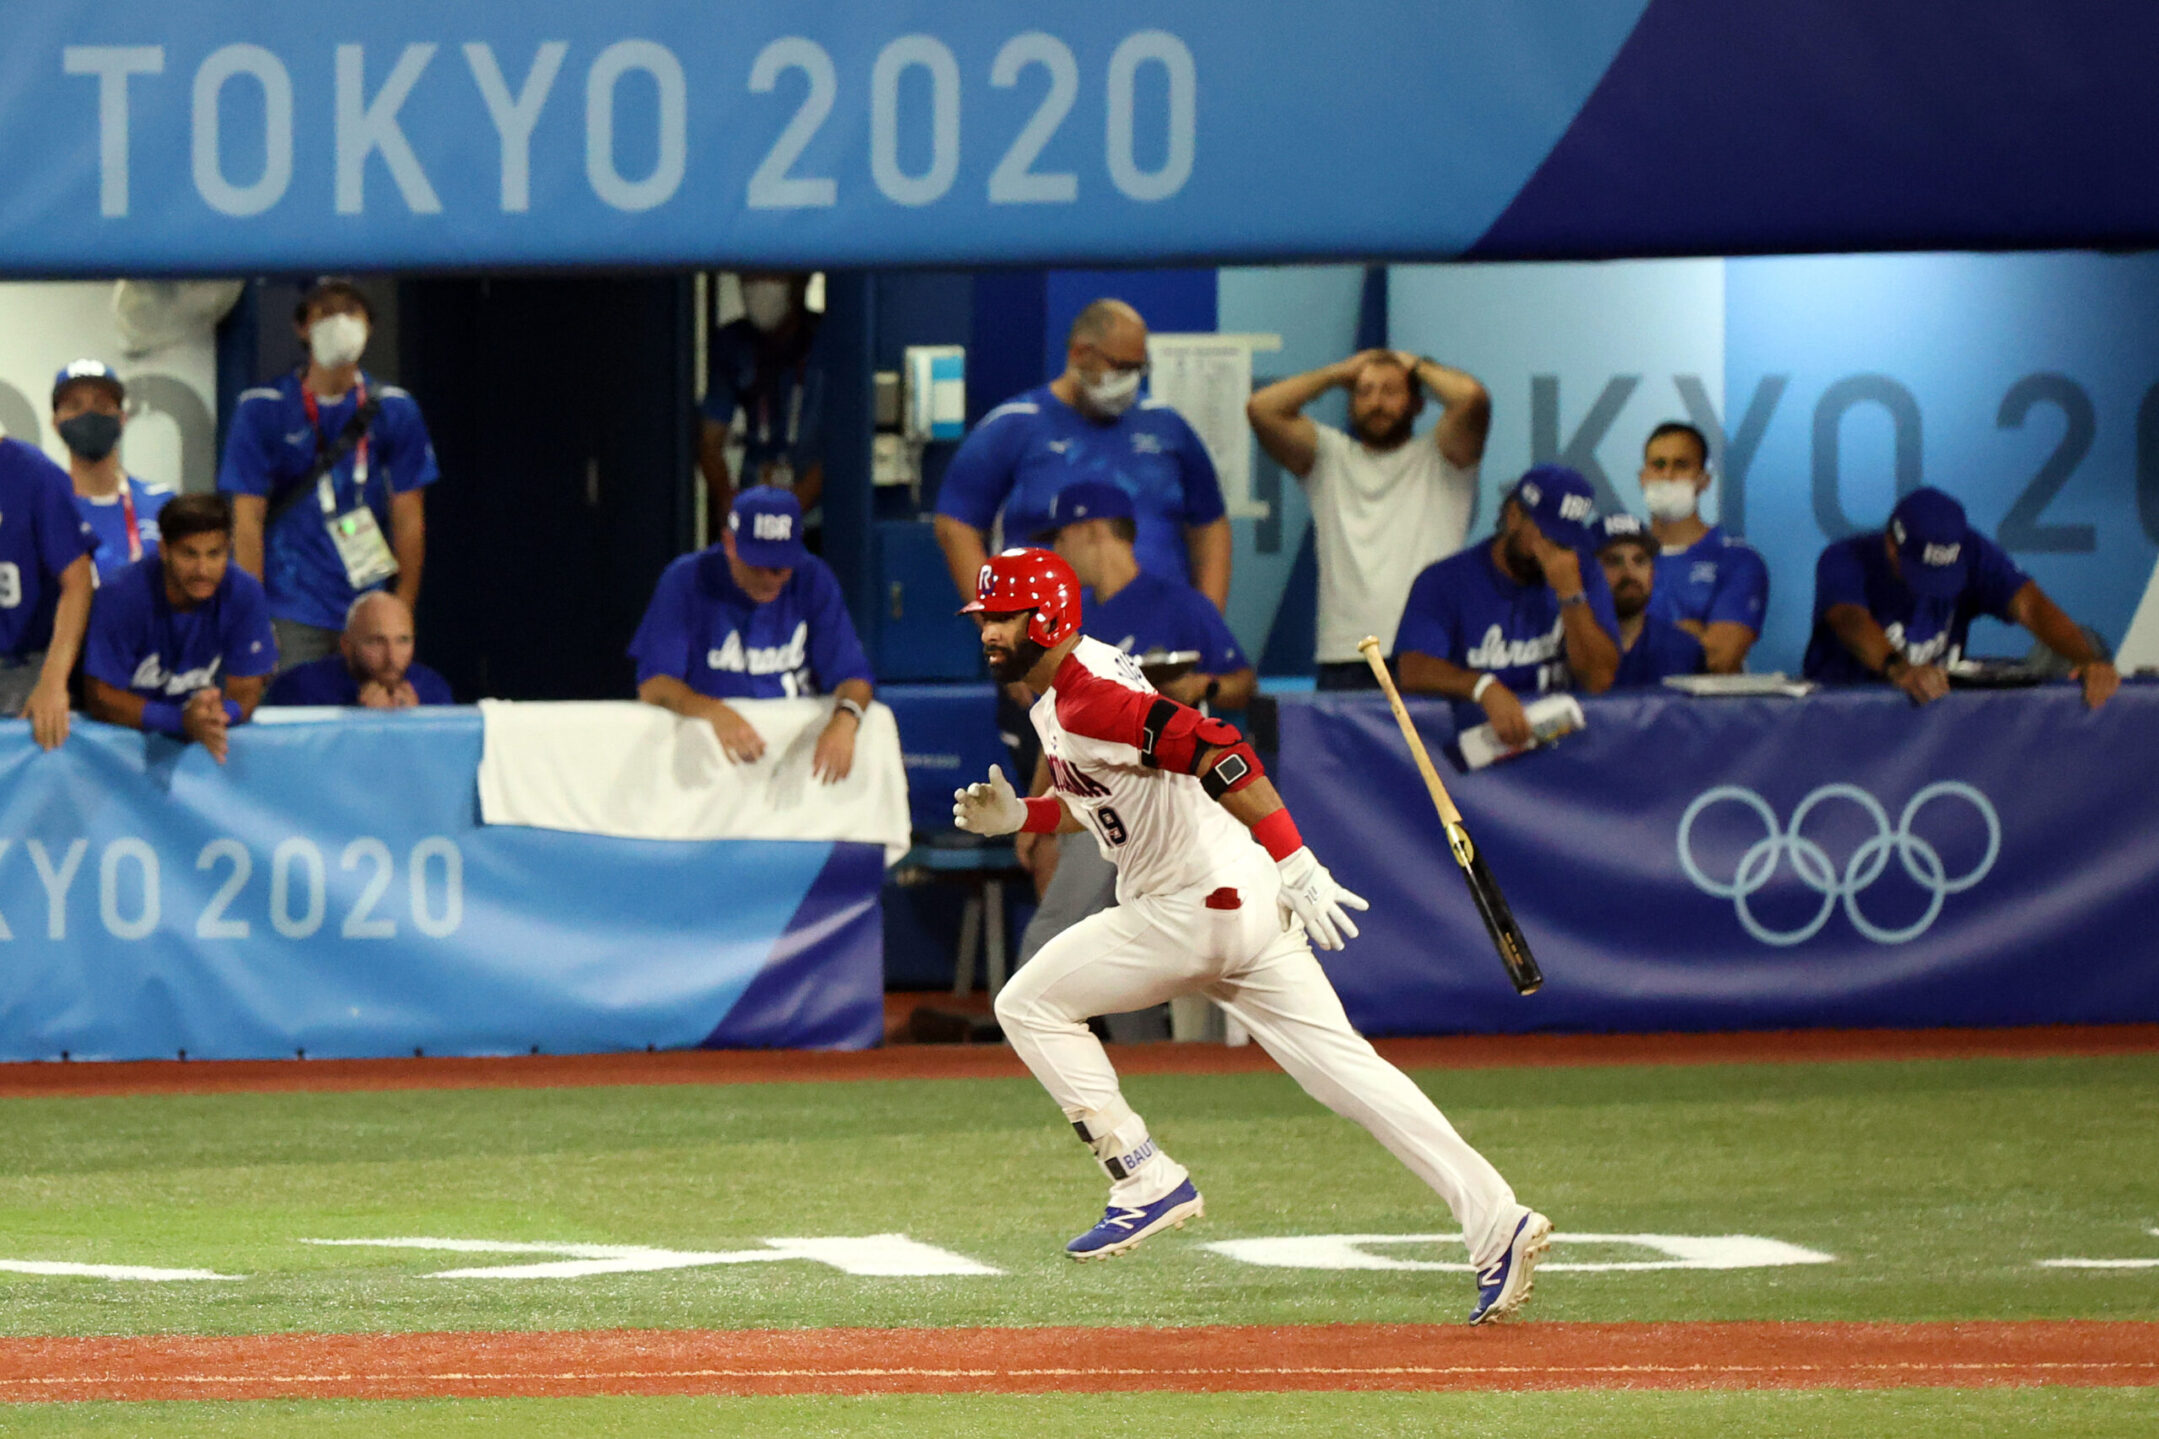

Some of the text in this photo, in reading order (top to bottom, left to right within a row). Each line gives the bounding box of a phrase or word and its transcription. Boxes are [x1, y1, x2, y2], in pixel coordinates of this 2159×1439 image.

[62, 29, 1197, 219] TOKYO 2020
[1087, 805, 1129, 849] 19
[0, 835, 464, 941] YO 2020
